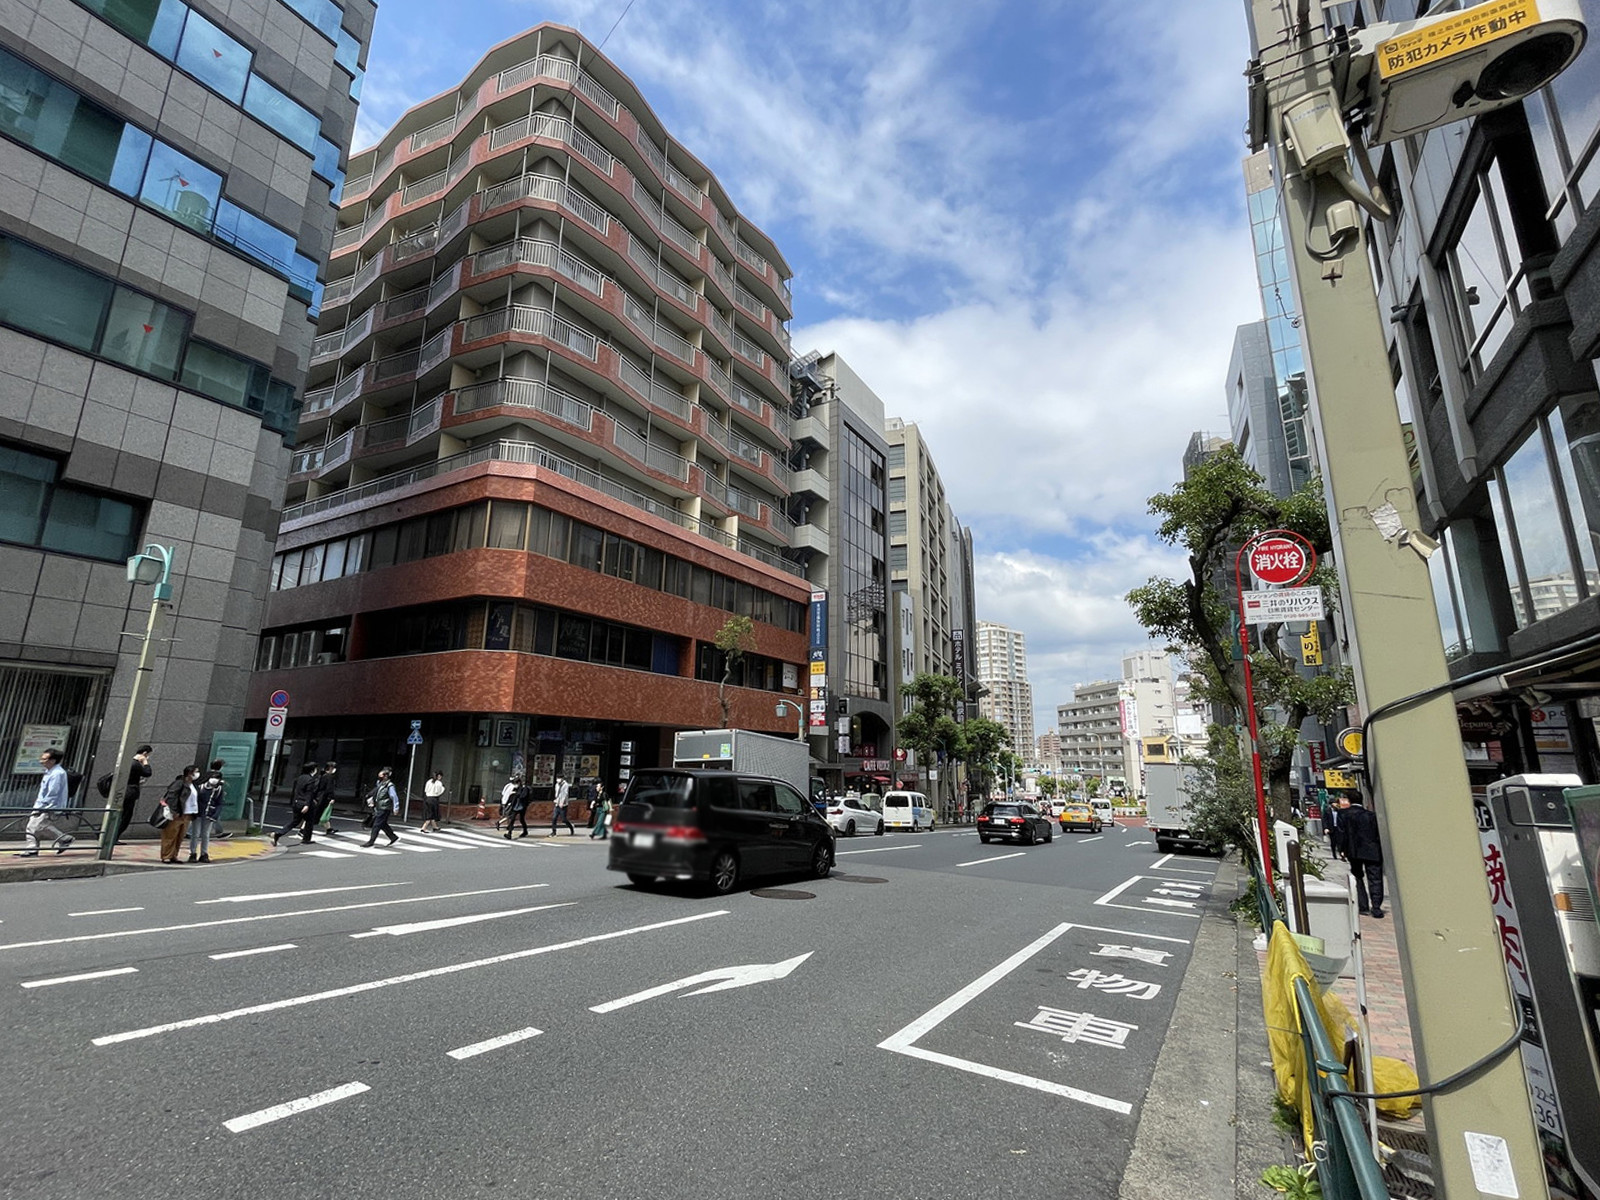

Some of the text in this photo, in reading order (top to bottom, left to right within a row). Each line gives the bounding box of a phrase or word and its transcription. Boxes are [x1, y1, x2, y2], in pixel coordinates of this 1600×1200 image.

[1388, 9, 1527, 70] 防犯カメラ作動中
[1270, 543, 1294, 551] HYDRANT
[1255, 551, 1300, 571] 消火栓
[1262, 597, 1319, 607] 三井のリハウス
